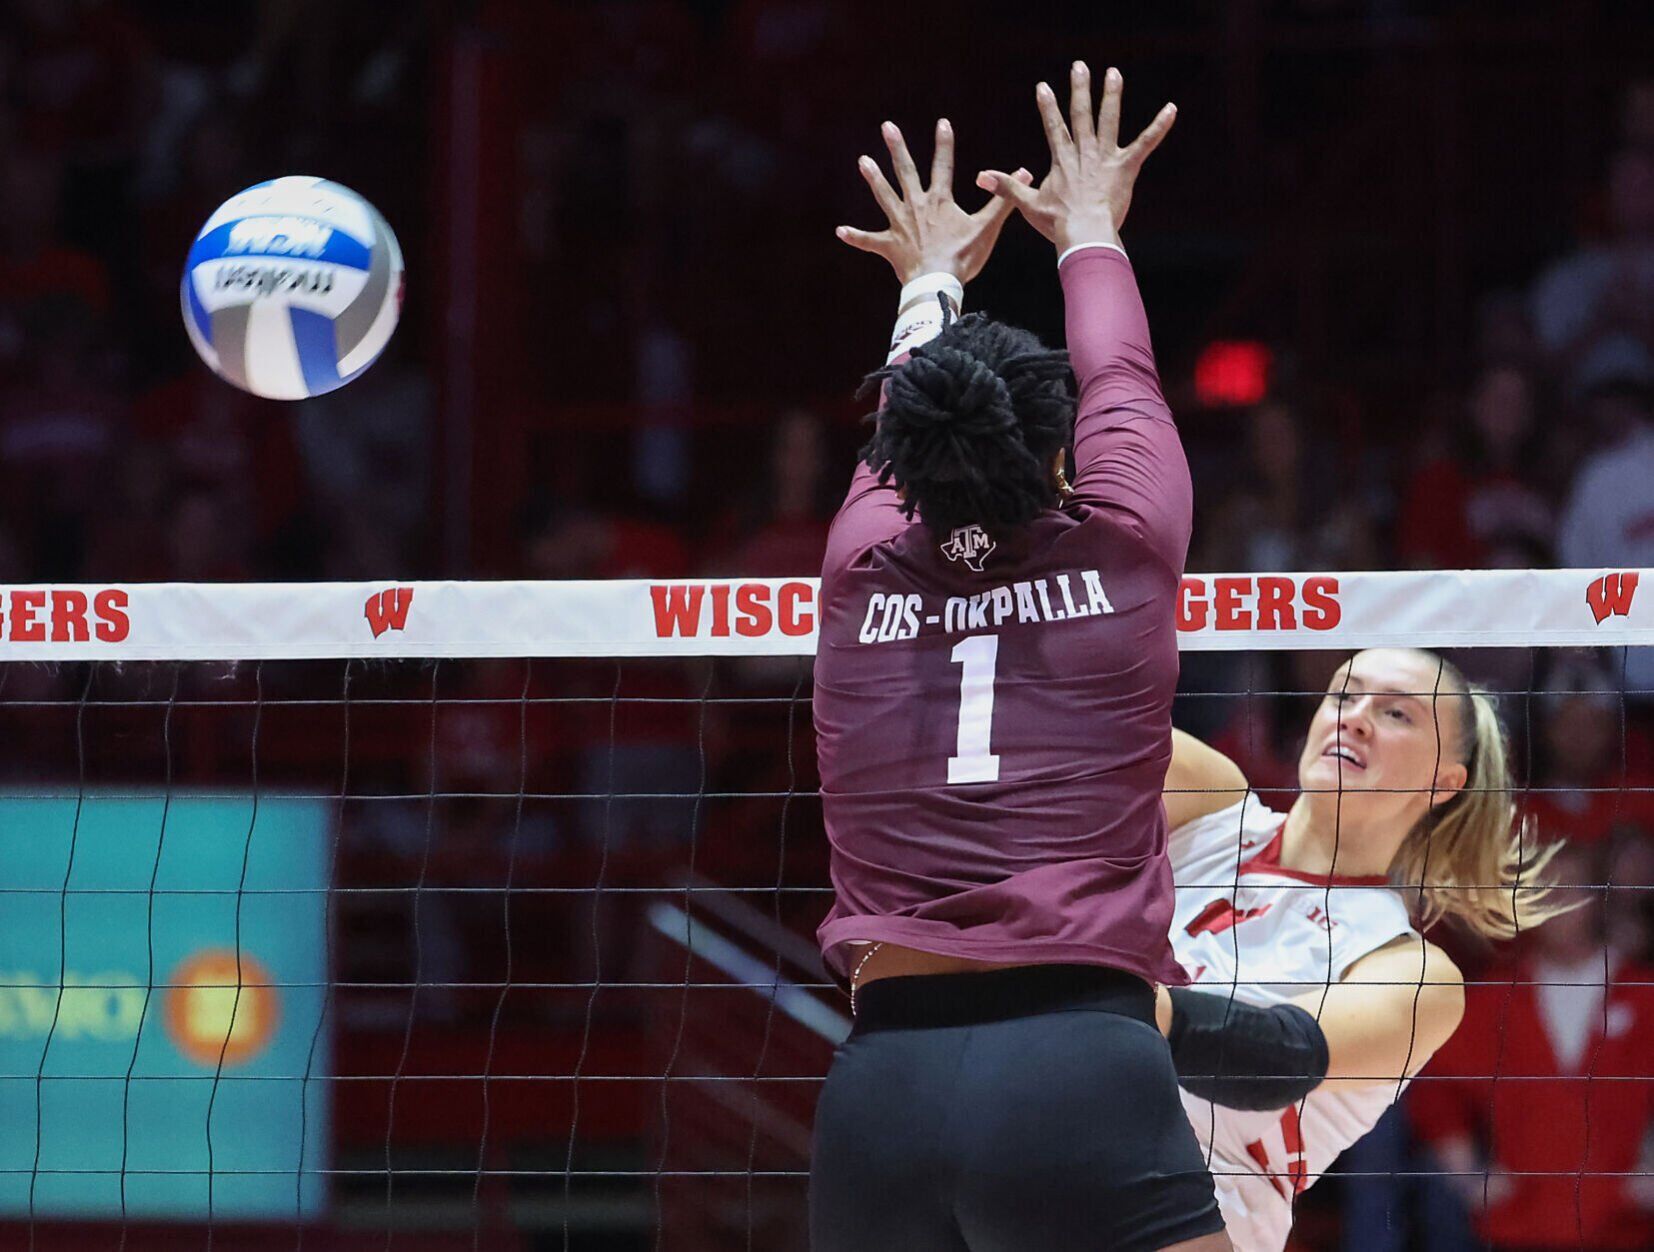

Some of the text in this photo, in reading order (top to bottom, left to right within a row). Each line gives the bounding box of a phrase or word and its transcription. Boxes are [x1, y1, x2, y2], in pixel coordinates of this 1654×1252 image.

[0, 589, 130, 643] ERS
[364, 587, 414, 640] W
[650, 578, 1341, 638] WISC GERS
[858, 570, 1115, 644] COS-OKPALLA
[1586, 572, 1640, 626] W
[947, 634, 1000, 784] 1
